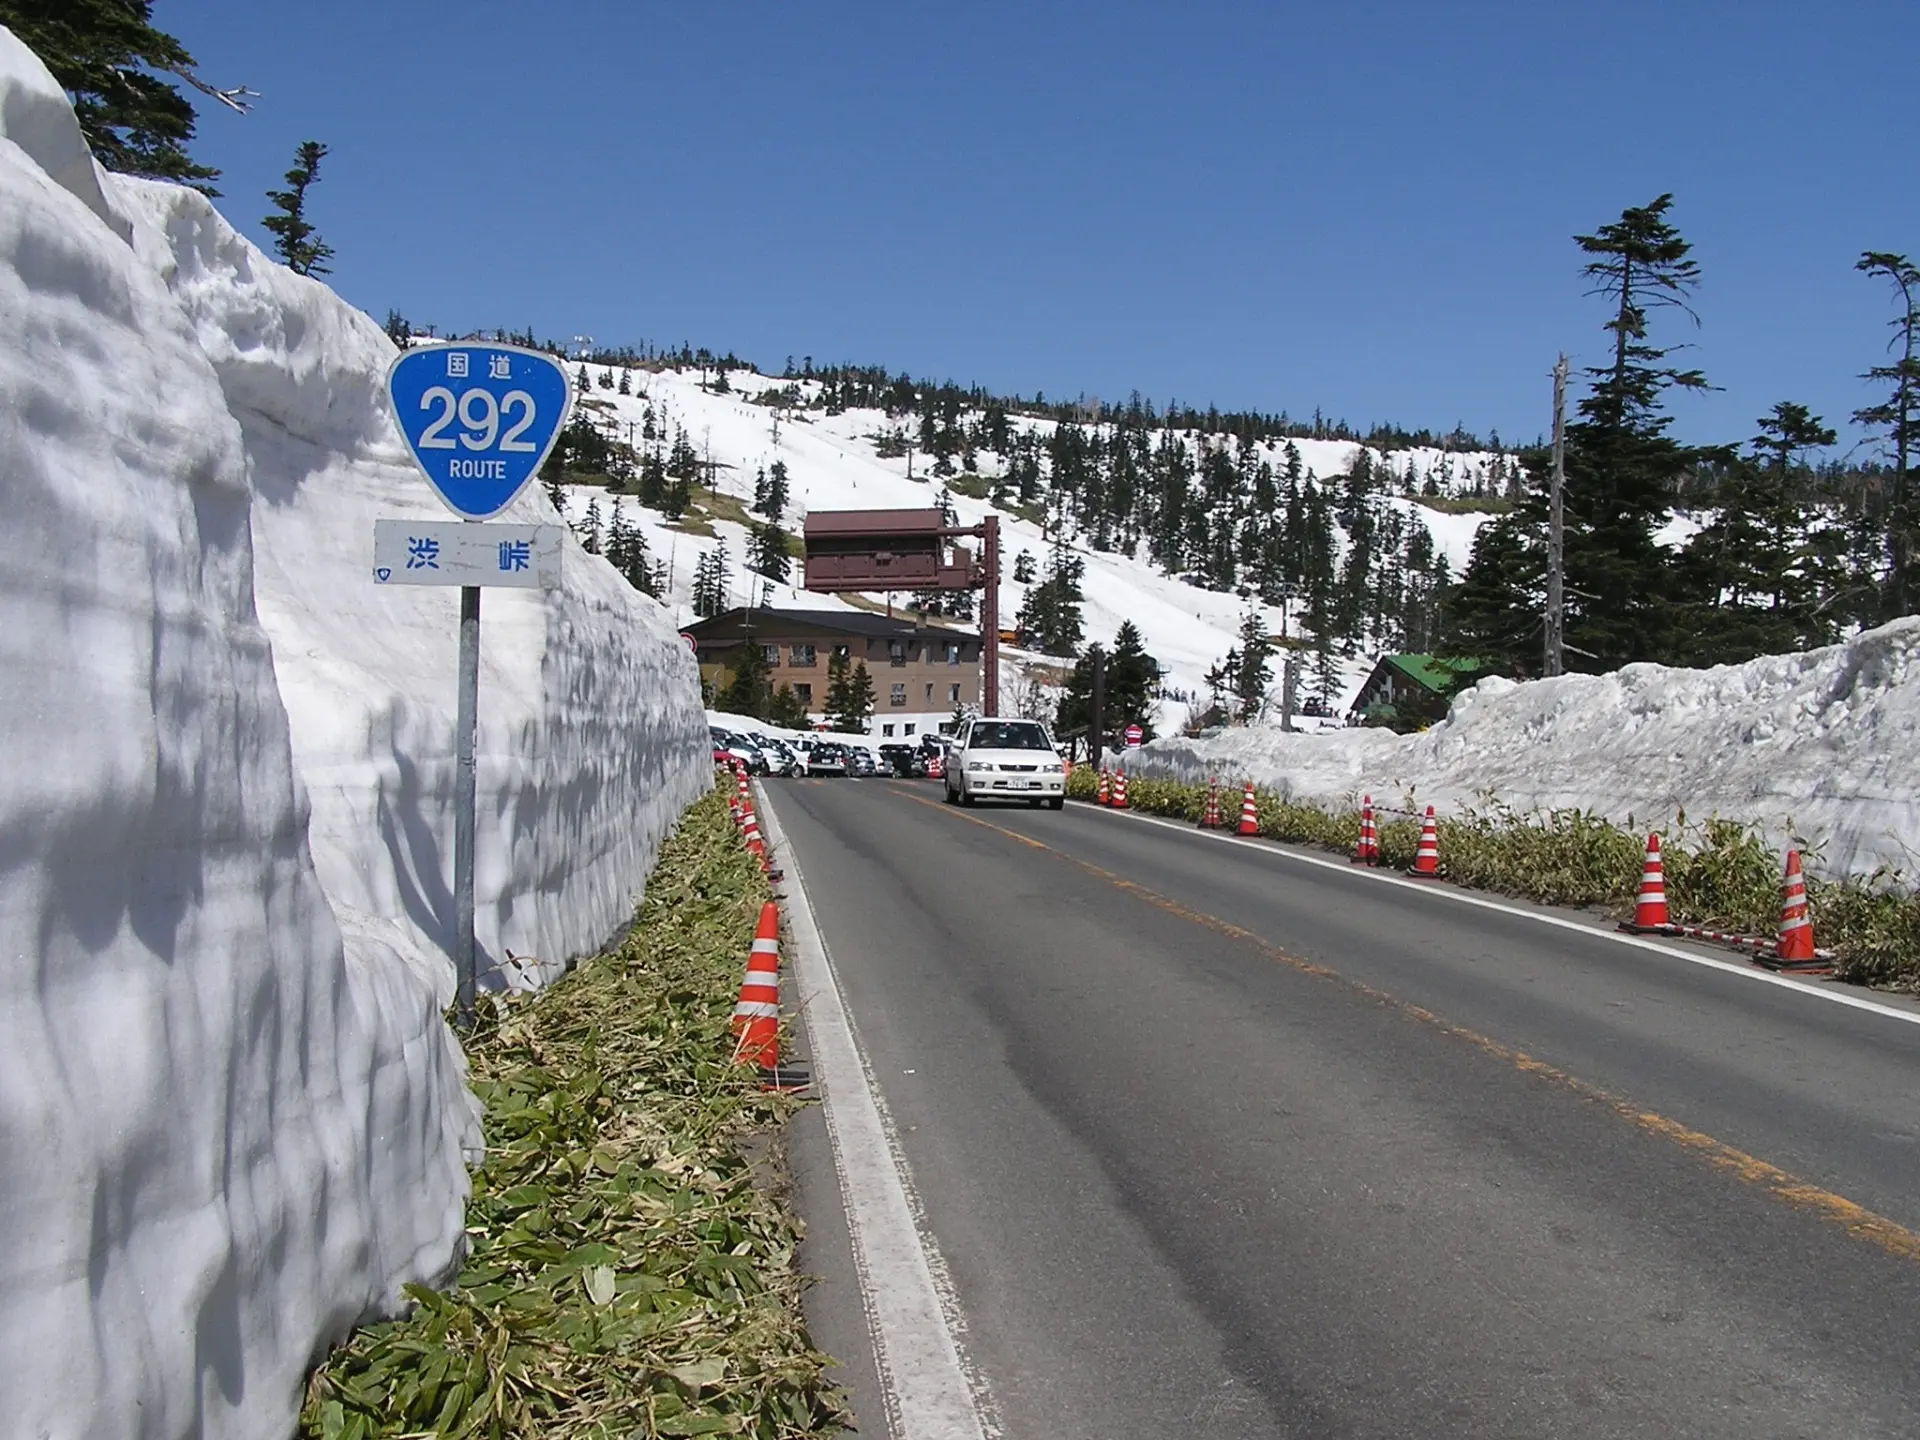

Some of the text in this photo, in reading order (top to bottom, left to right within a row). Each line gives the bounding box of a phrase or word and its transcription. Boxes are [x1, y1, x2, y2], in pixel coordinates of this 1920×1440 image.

[447, 353, 512, 379] 国道
[418, 386, 536, 453] 292
[450, 460, 506, 479] ROUTE
[406, 536, 530, 572] 渋峠
